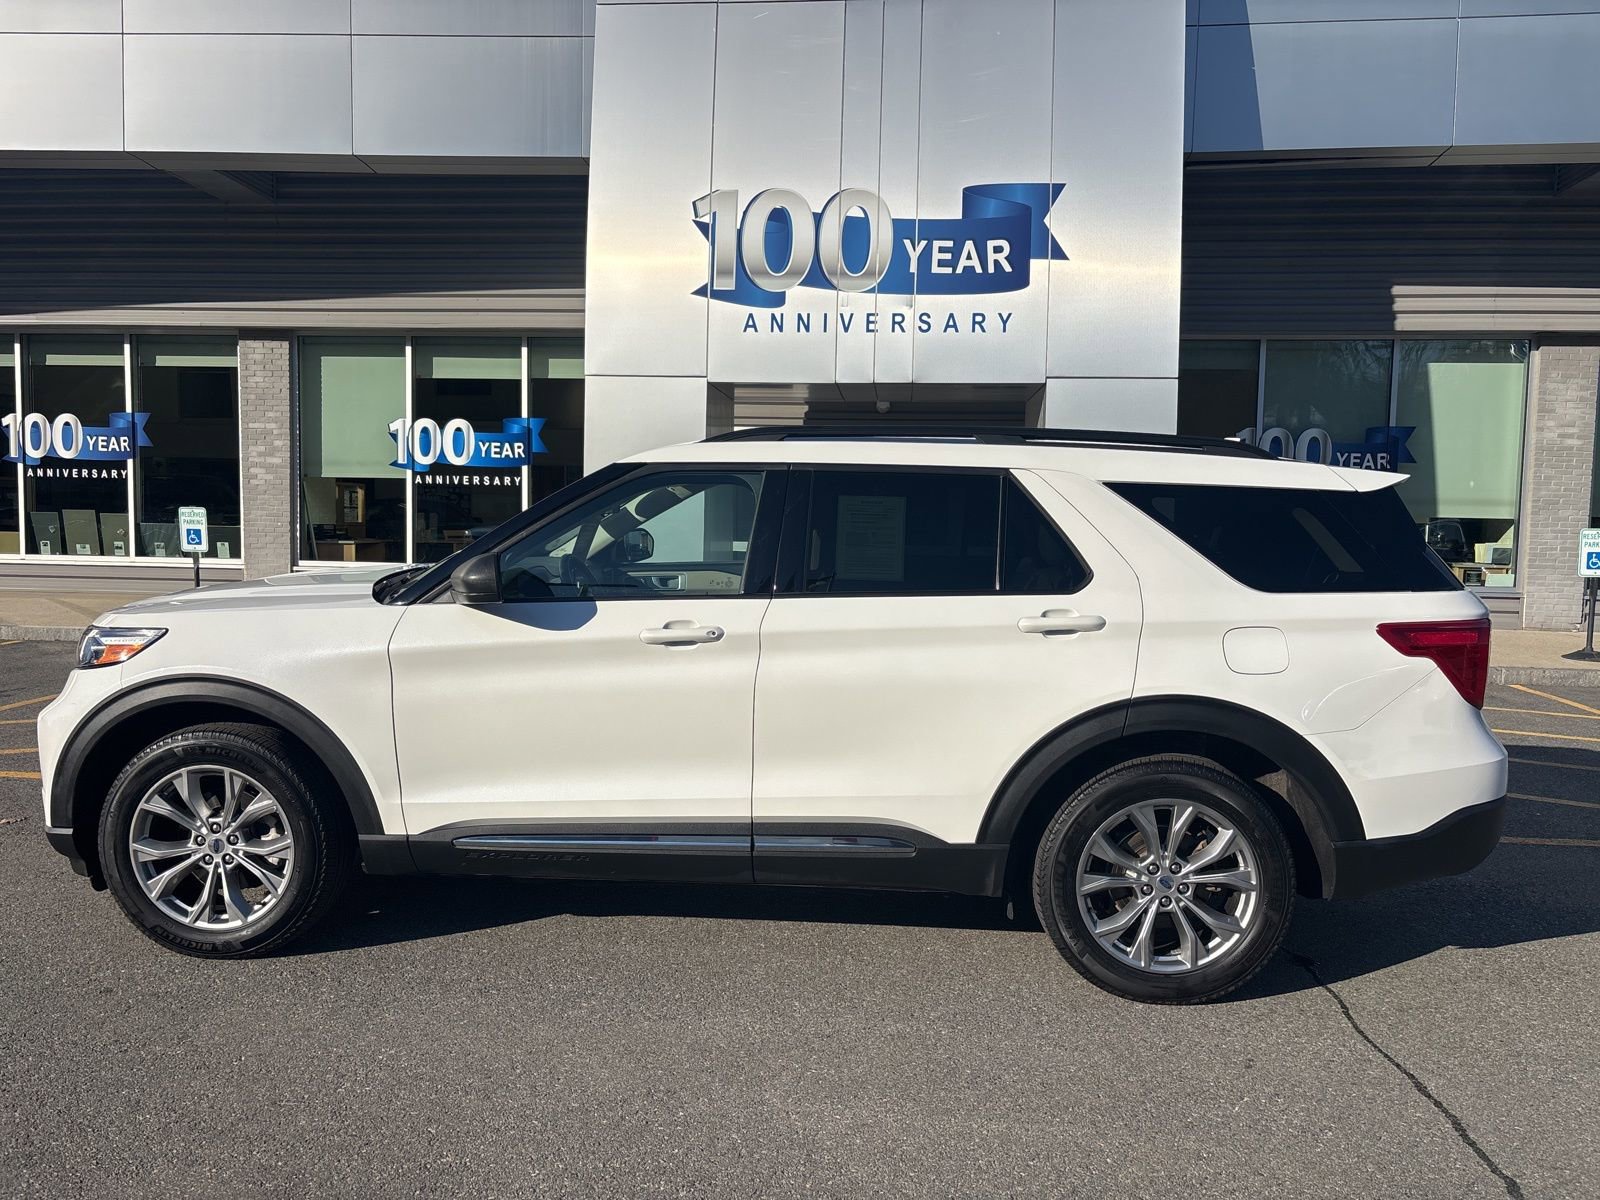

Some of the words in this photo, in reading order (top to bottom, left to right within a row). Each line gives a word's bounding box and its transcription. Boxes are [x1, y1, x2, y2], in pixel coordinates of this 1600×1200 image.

[692, 187, 894, 293] 100
[902, 239, 1013, 274] YEAR
[743, 312, 1014, 333] ANNIVERSARY
[1, 412, 83, 459] 100
[86, 435, 131, 452] YEAR
[388, 417, 475, 466] 100
[478, 441, 526, 459] YEAR
[1336, 452, 1391, 469] YEAR
[27, 467, 128, 479] ANNIVERSARY
[415, 474, 521, 487] ANNIVERSARY
